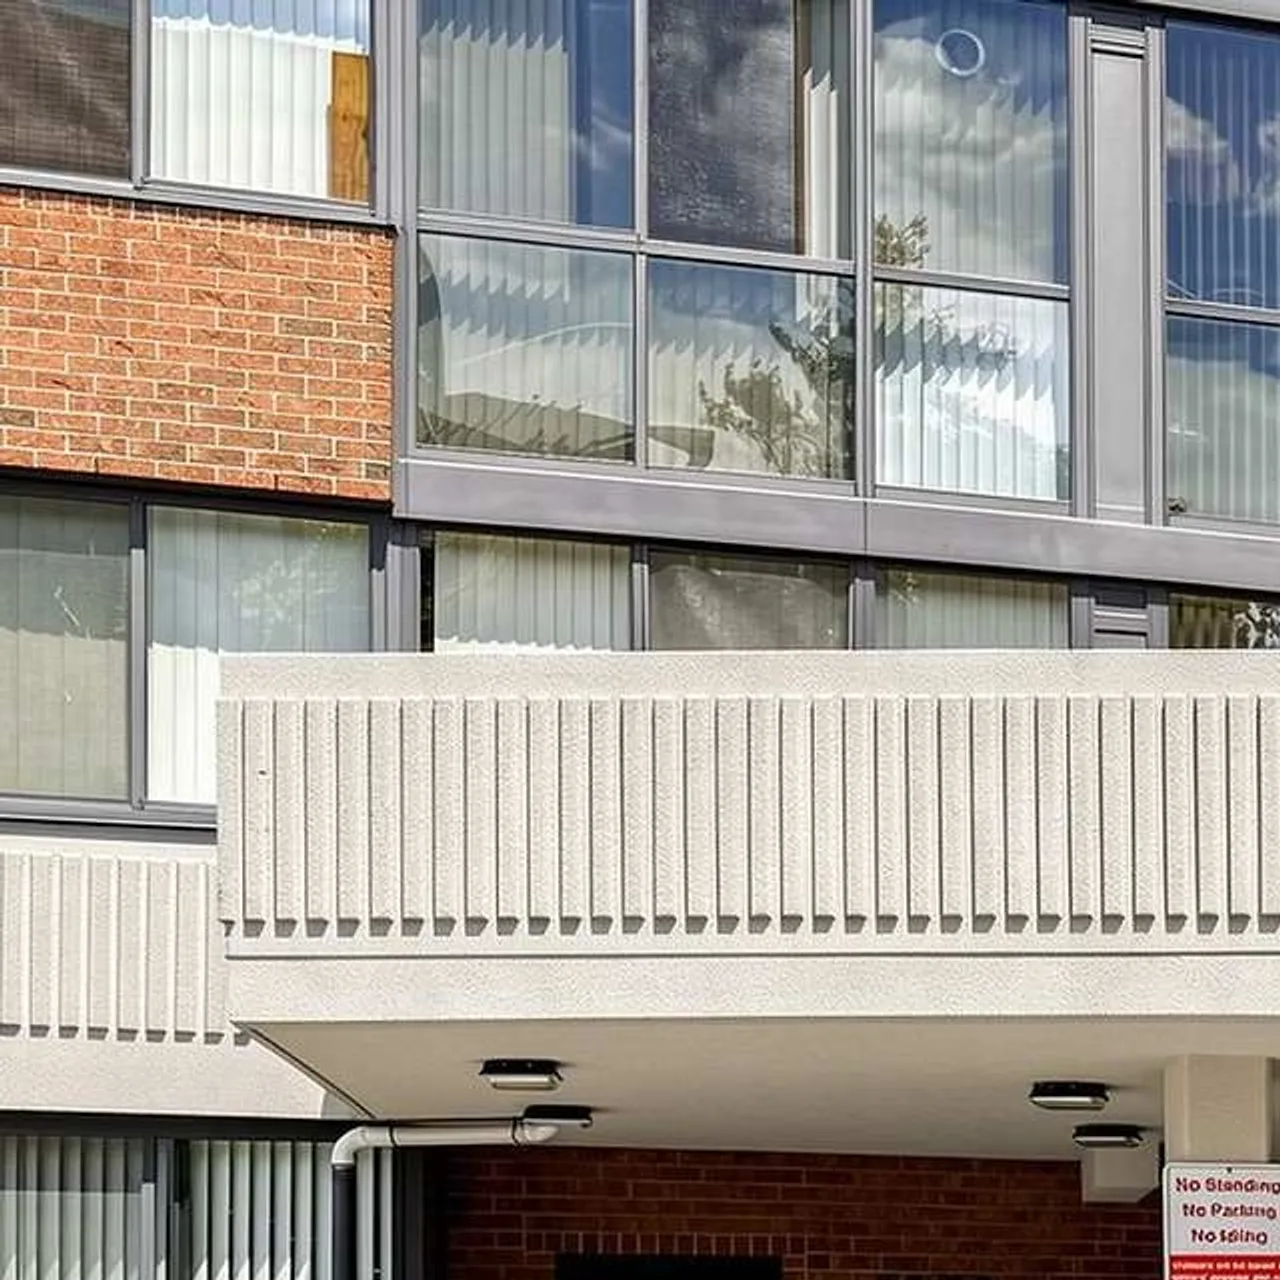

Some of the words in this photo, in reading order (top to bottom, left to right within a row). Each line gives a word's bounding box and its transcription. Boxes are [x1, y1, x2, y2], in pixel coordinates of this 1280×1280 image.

[1175, 1177, 1201, 1193] No
[1182, 1203, 1207, 1218] No
[1211, 1203, 1277, 1220] Parking
[1191, 1229, 1217, 1243] No
